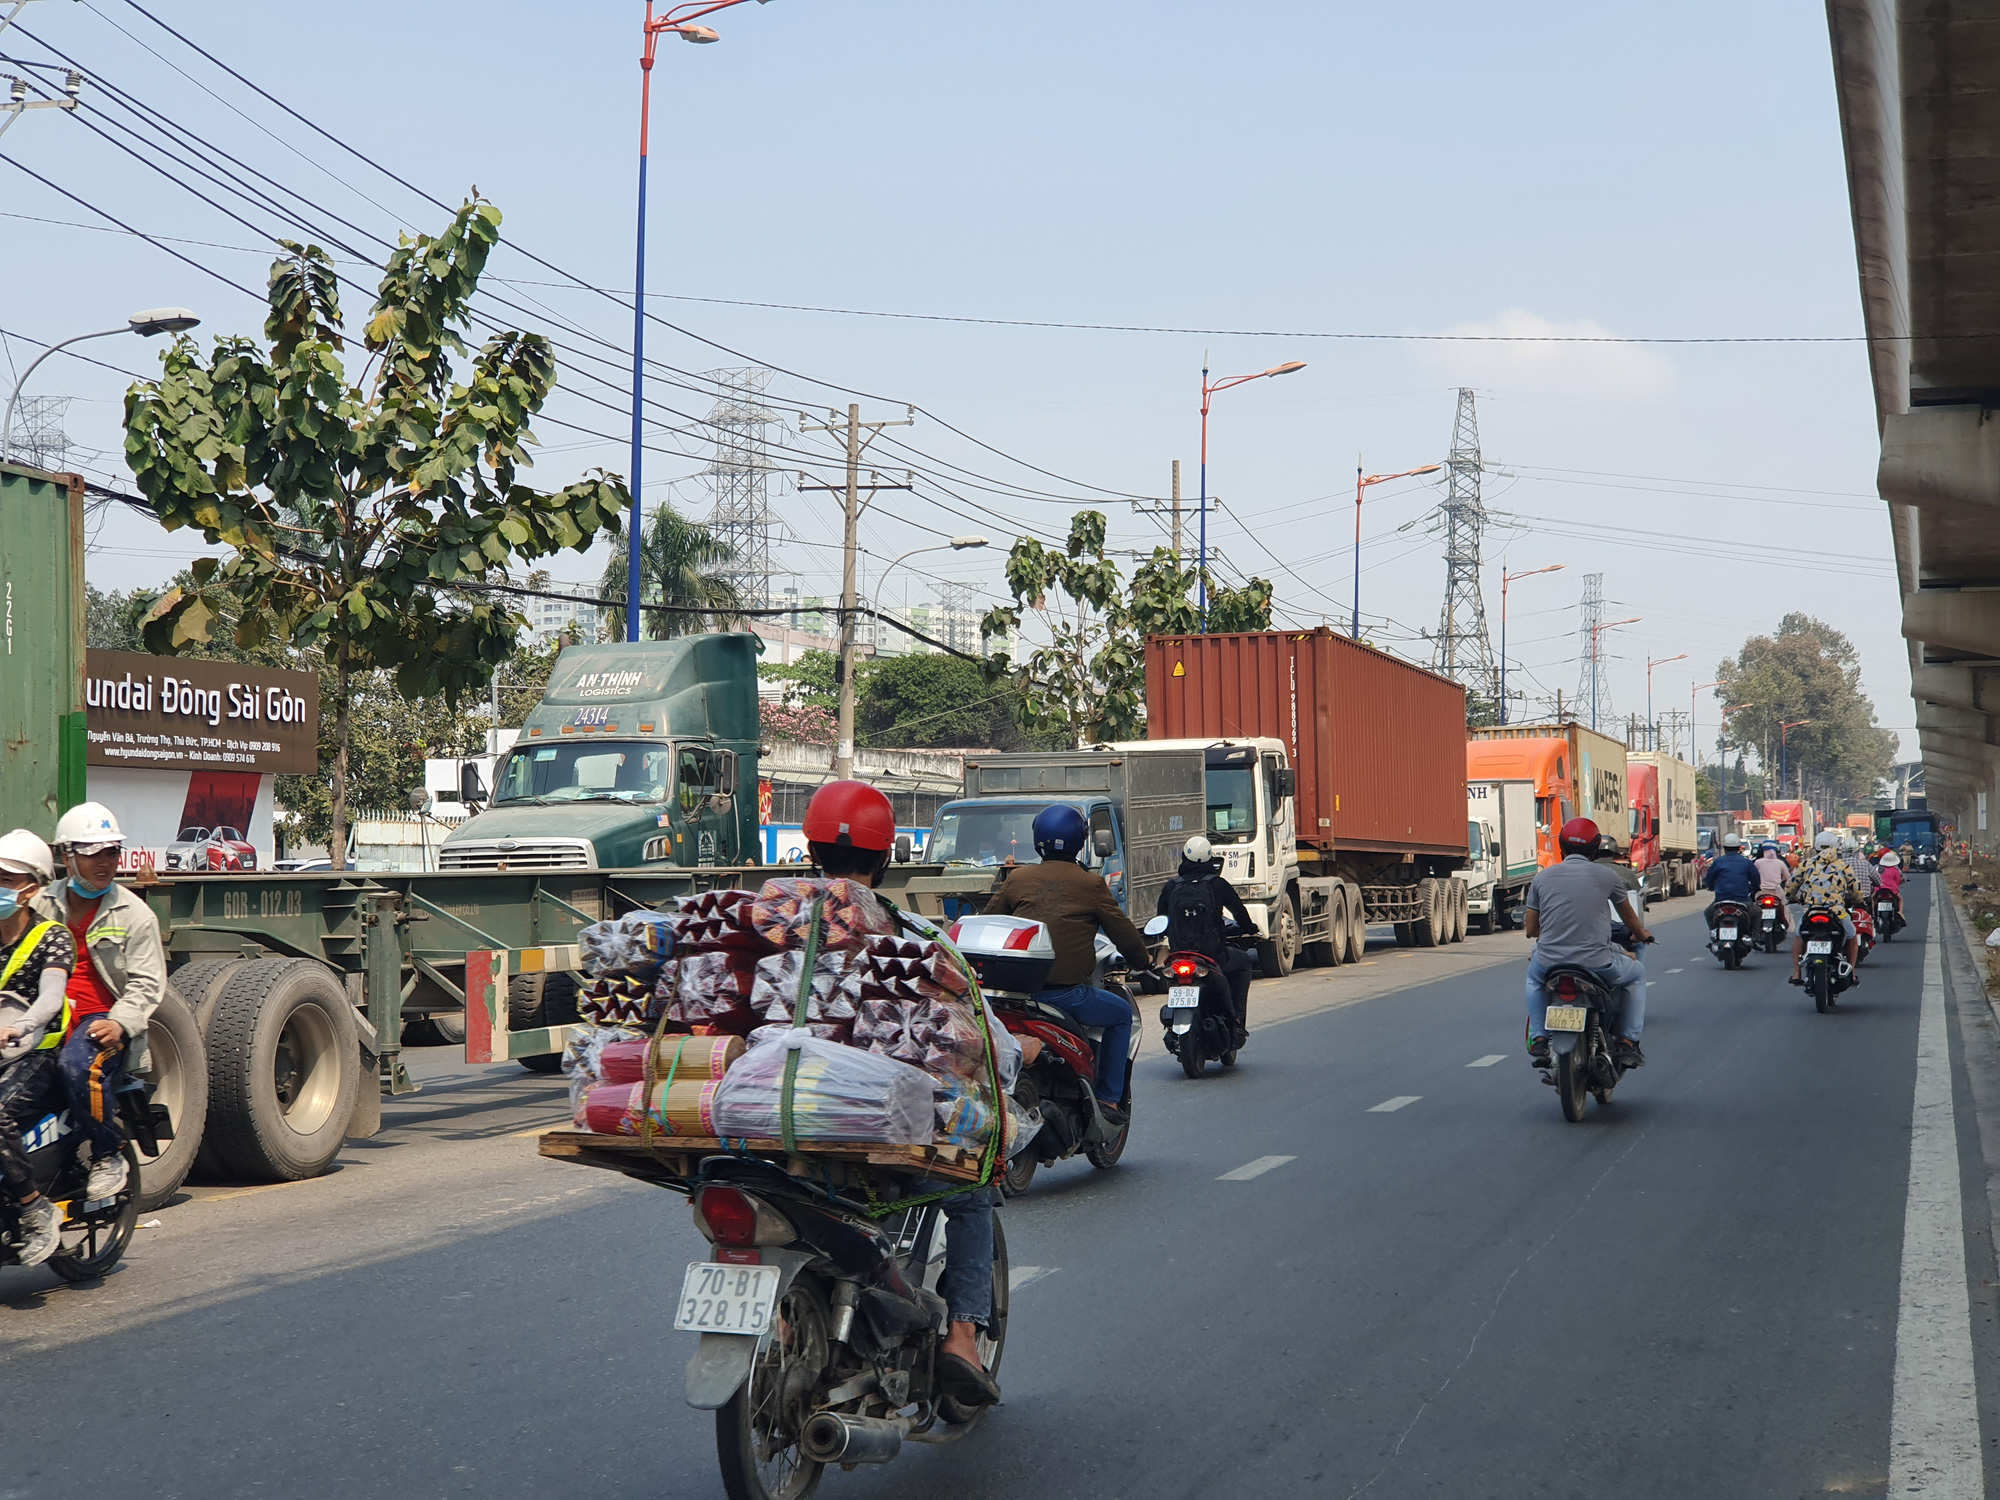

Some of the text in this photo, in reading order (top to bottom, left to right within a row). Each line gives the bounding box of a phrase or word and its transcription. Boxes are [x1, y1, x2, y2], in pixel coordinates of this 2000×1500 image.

[5, 582, 13, 655] 22G1
[161, 676, 221, 726] Đông
[227, 683, 260, 720] Sài
[266, 686, 306, 723] Gòn
[580, 687, 632, 697] LOGISTICS
[574, 707, 610, 725] 24314
[104, 746, 183, 761] www.hyundaidongsaigon.vn
[222, 752, 235, 762] 0909
[1292, 748, 1297, 758] 3
[1228, 851, 1239, 859] SM
[223, 891, 248, 920] 60R
[260, 890, 302, 918] 012.03
[697, 1268, 763, 1298] 70-B1
[682, 1298, 766, 1329] 328.15
